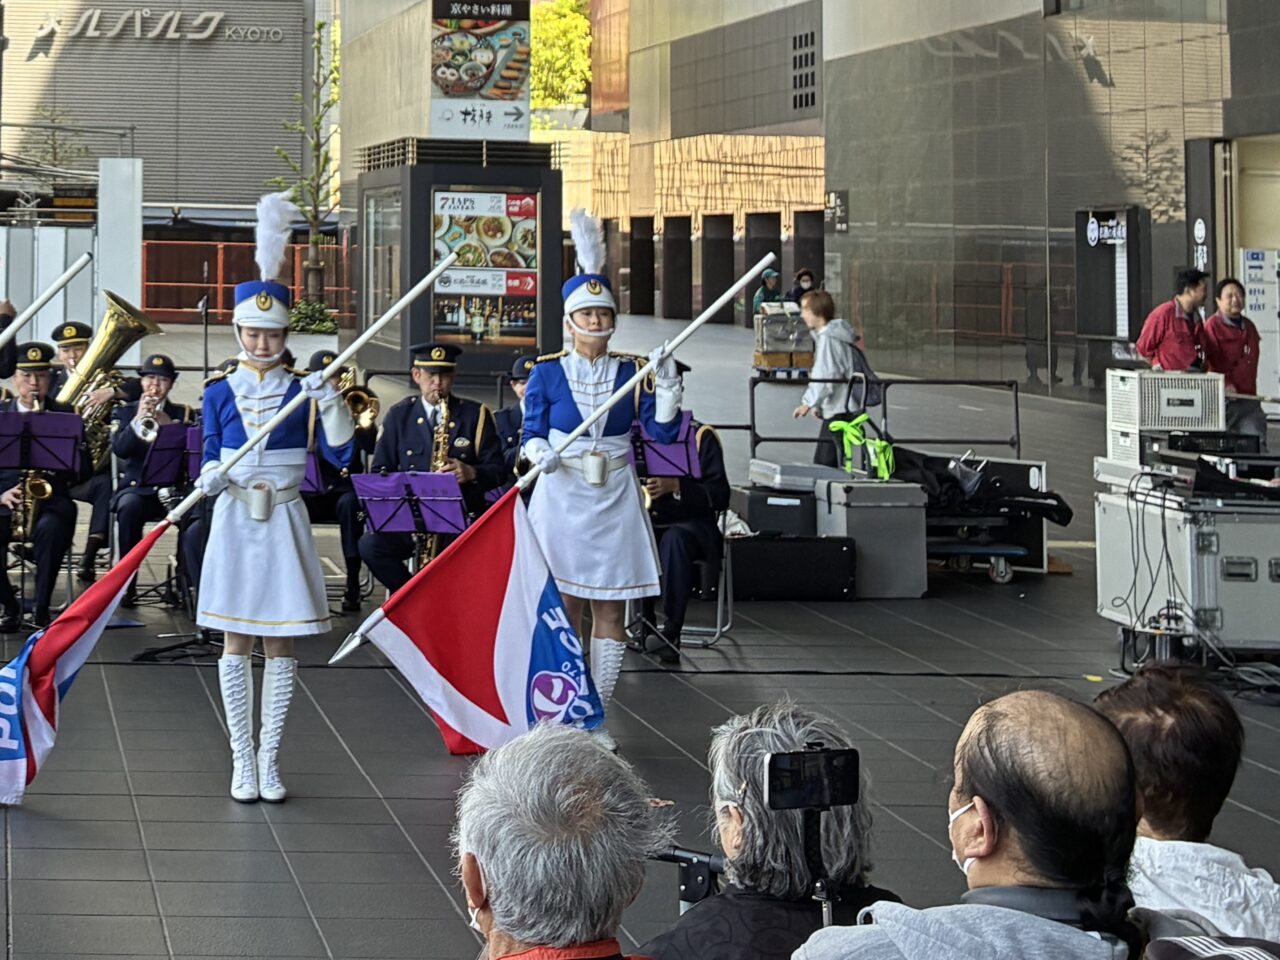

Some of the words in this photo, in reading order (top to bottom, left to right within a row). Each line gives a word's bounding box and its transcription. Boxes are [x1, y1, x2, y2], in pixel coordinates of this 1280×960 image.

[450, 2, 512, 16] 京やさい料理
[36, 8, 224, 39] メルパルク
[225, 26, 283, 41] KYOTO
